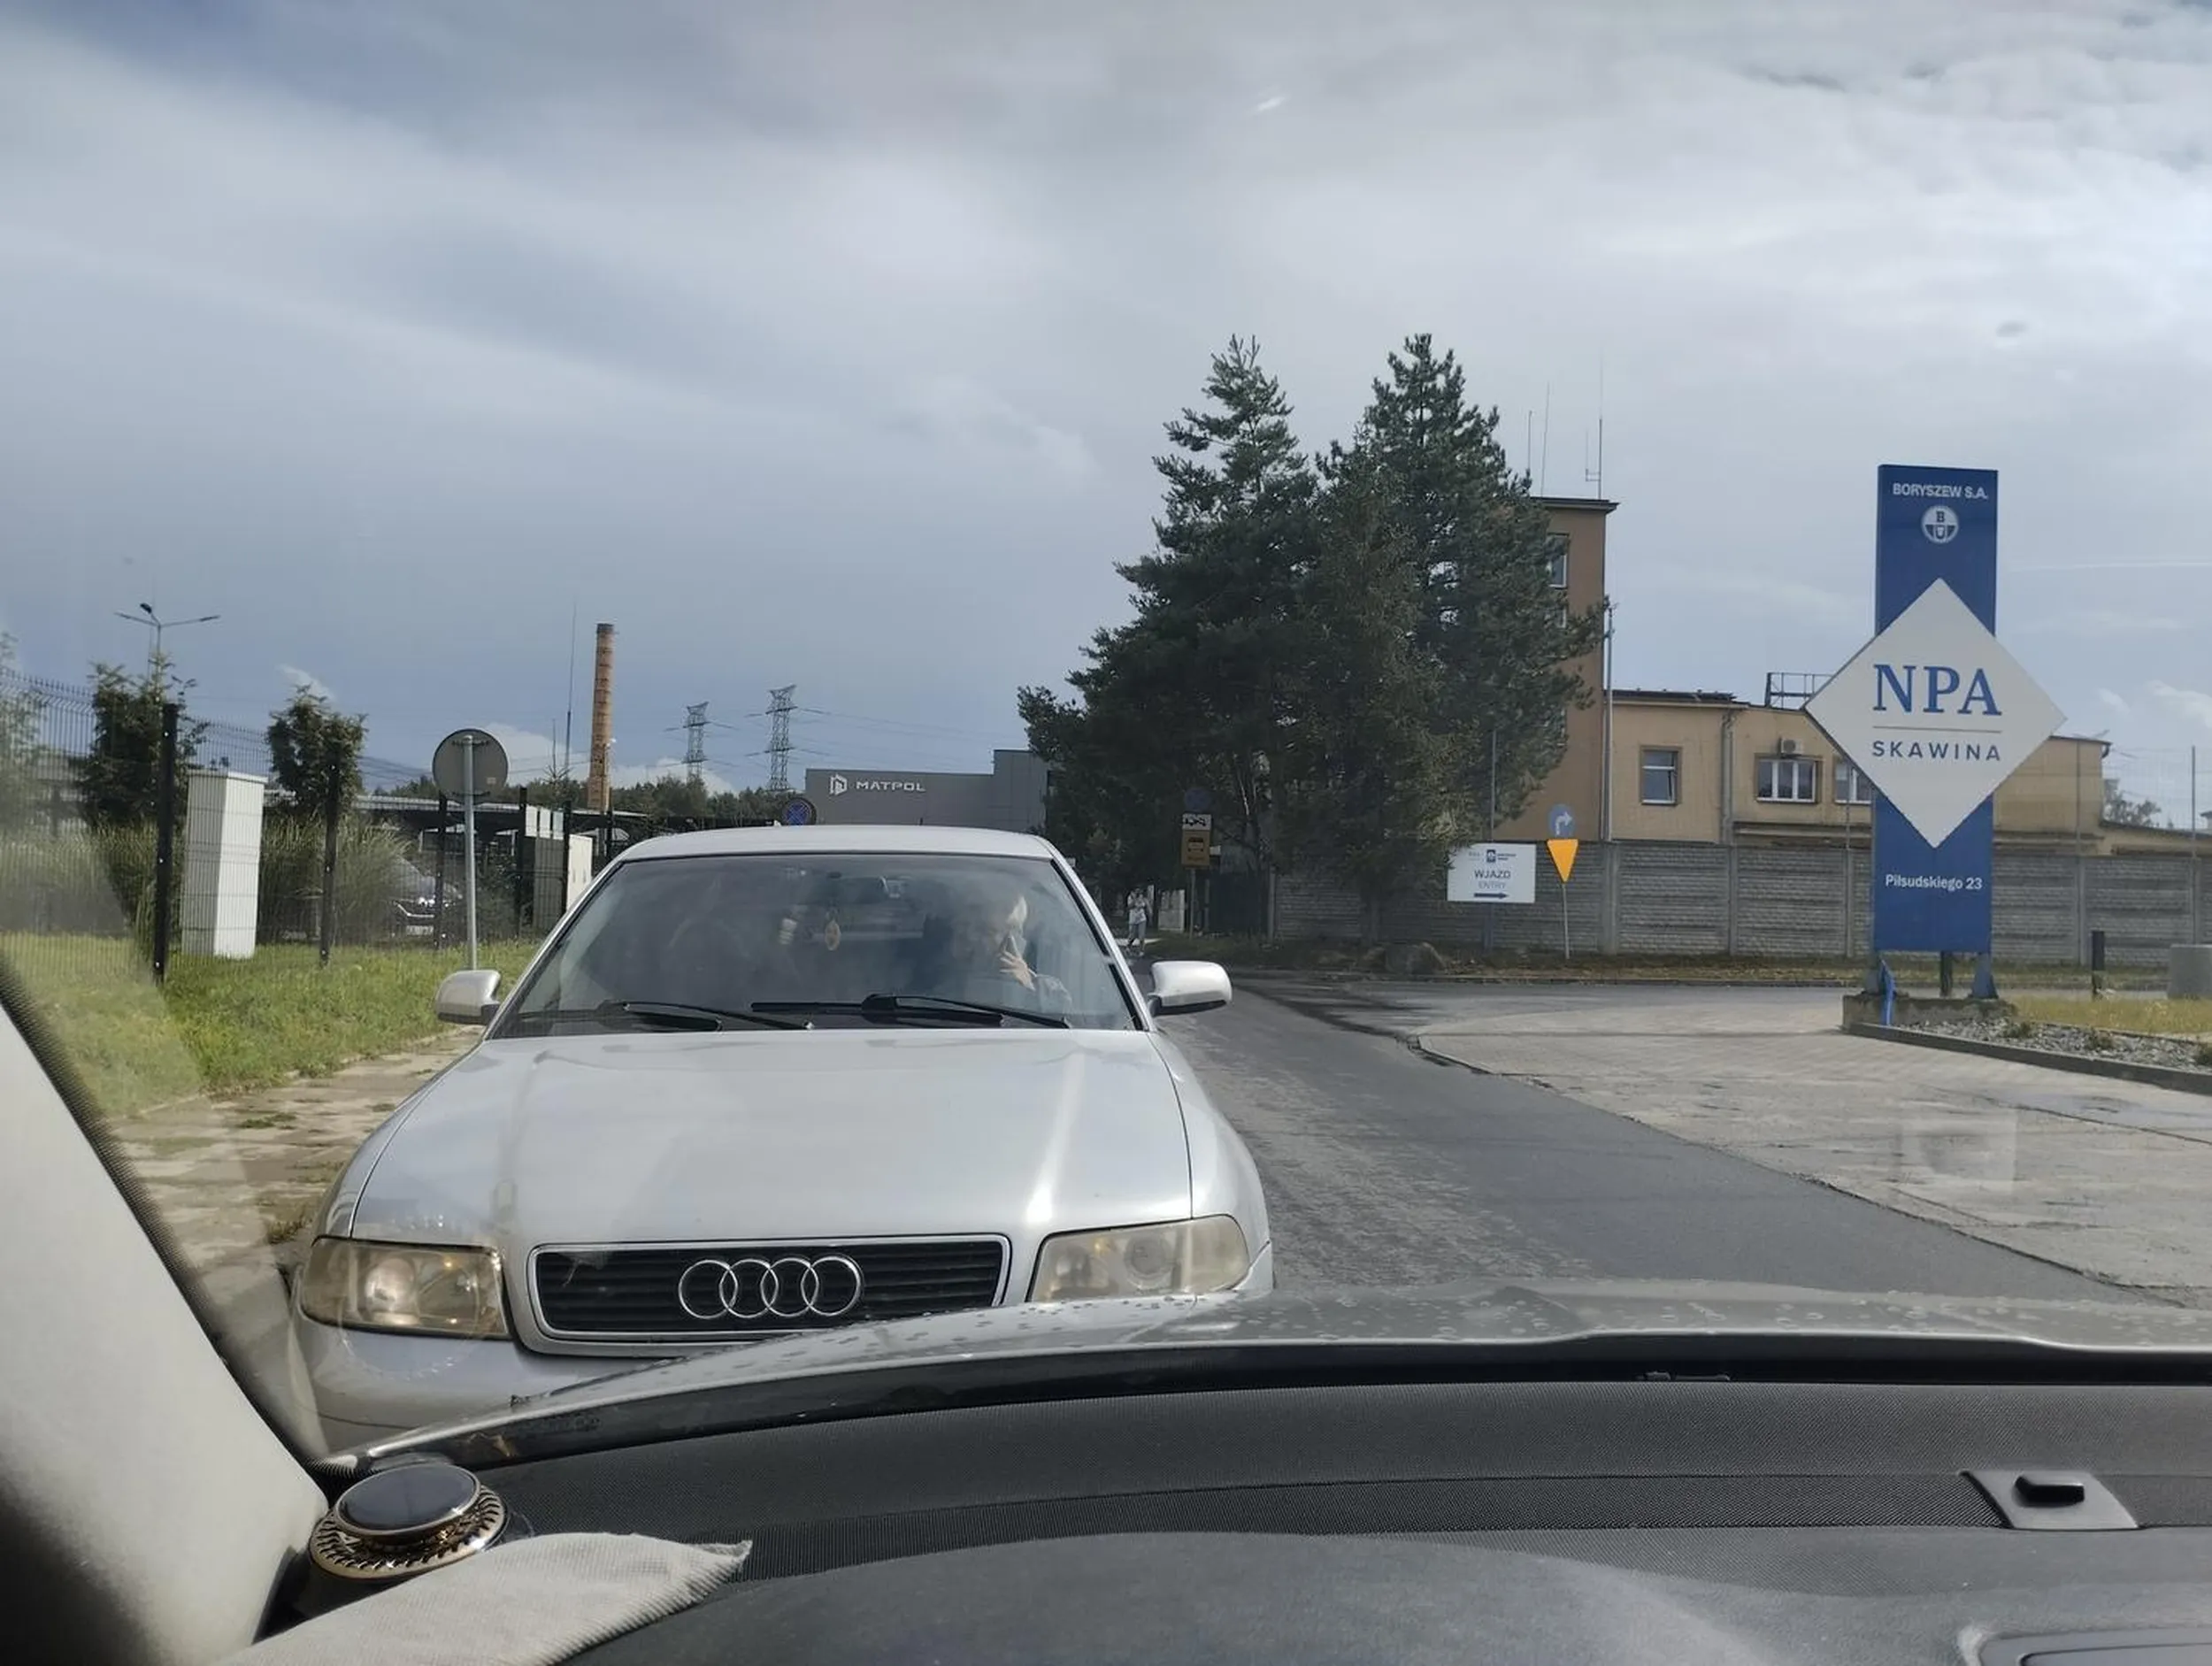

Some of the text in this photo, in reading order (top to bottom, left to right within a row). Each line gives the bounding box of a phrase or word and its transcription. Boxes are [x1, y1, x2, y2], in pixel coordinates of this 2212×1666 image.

[1893, 482, 1988, 500] BORYSZEW S.A.
[1872, 664, 2002, 716] NPA
[1872, 741, 2001, 761] SKAWINA
[856, 781, 926, 793] MATPOL
[1474, 870, 1511, 879] WJAZD
[1965, 877, 1983, 890] 23
